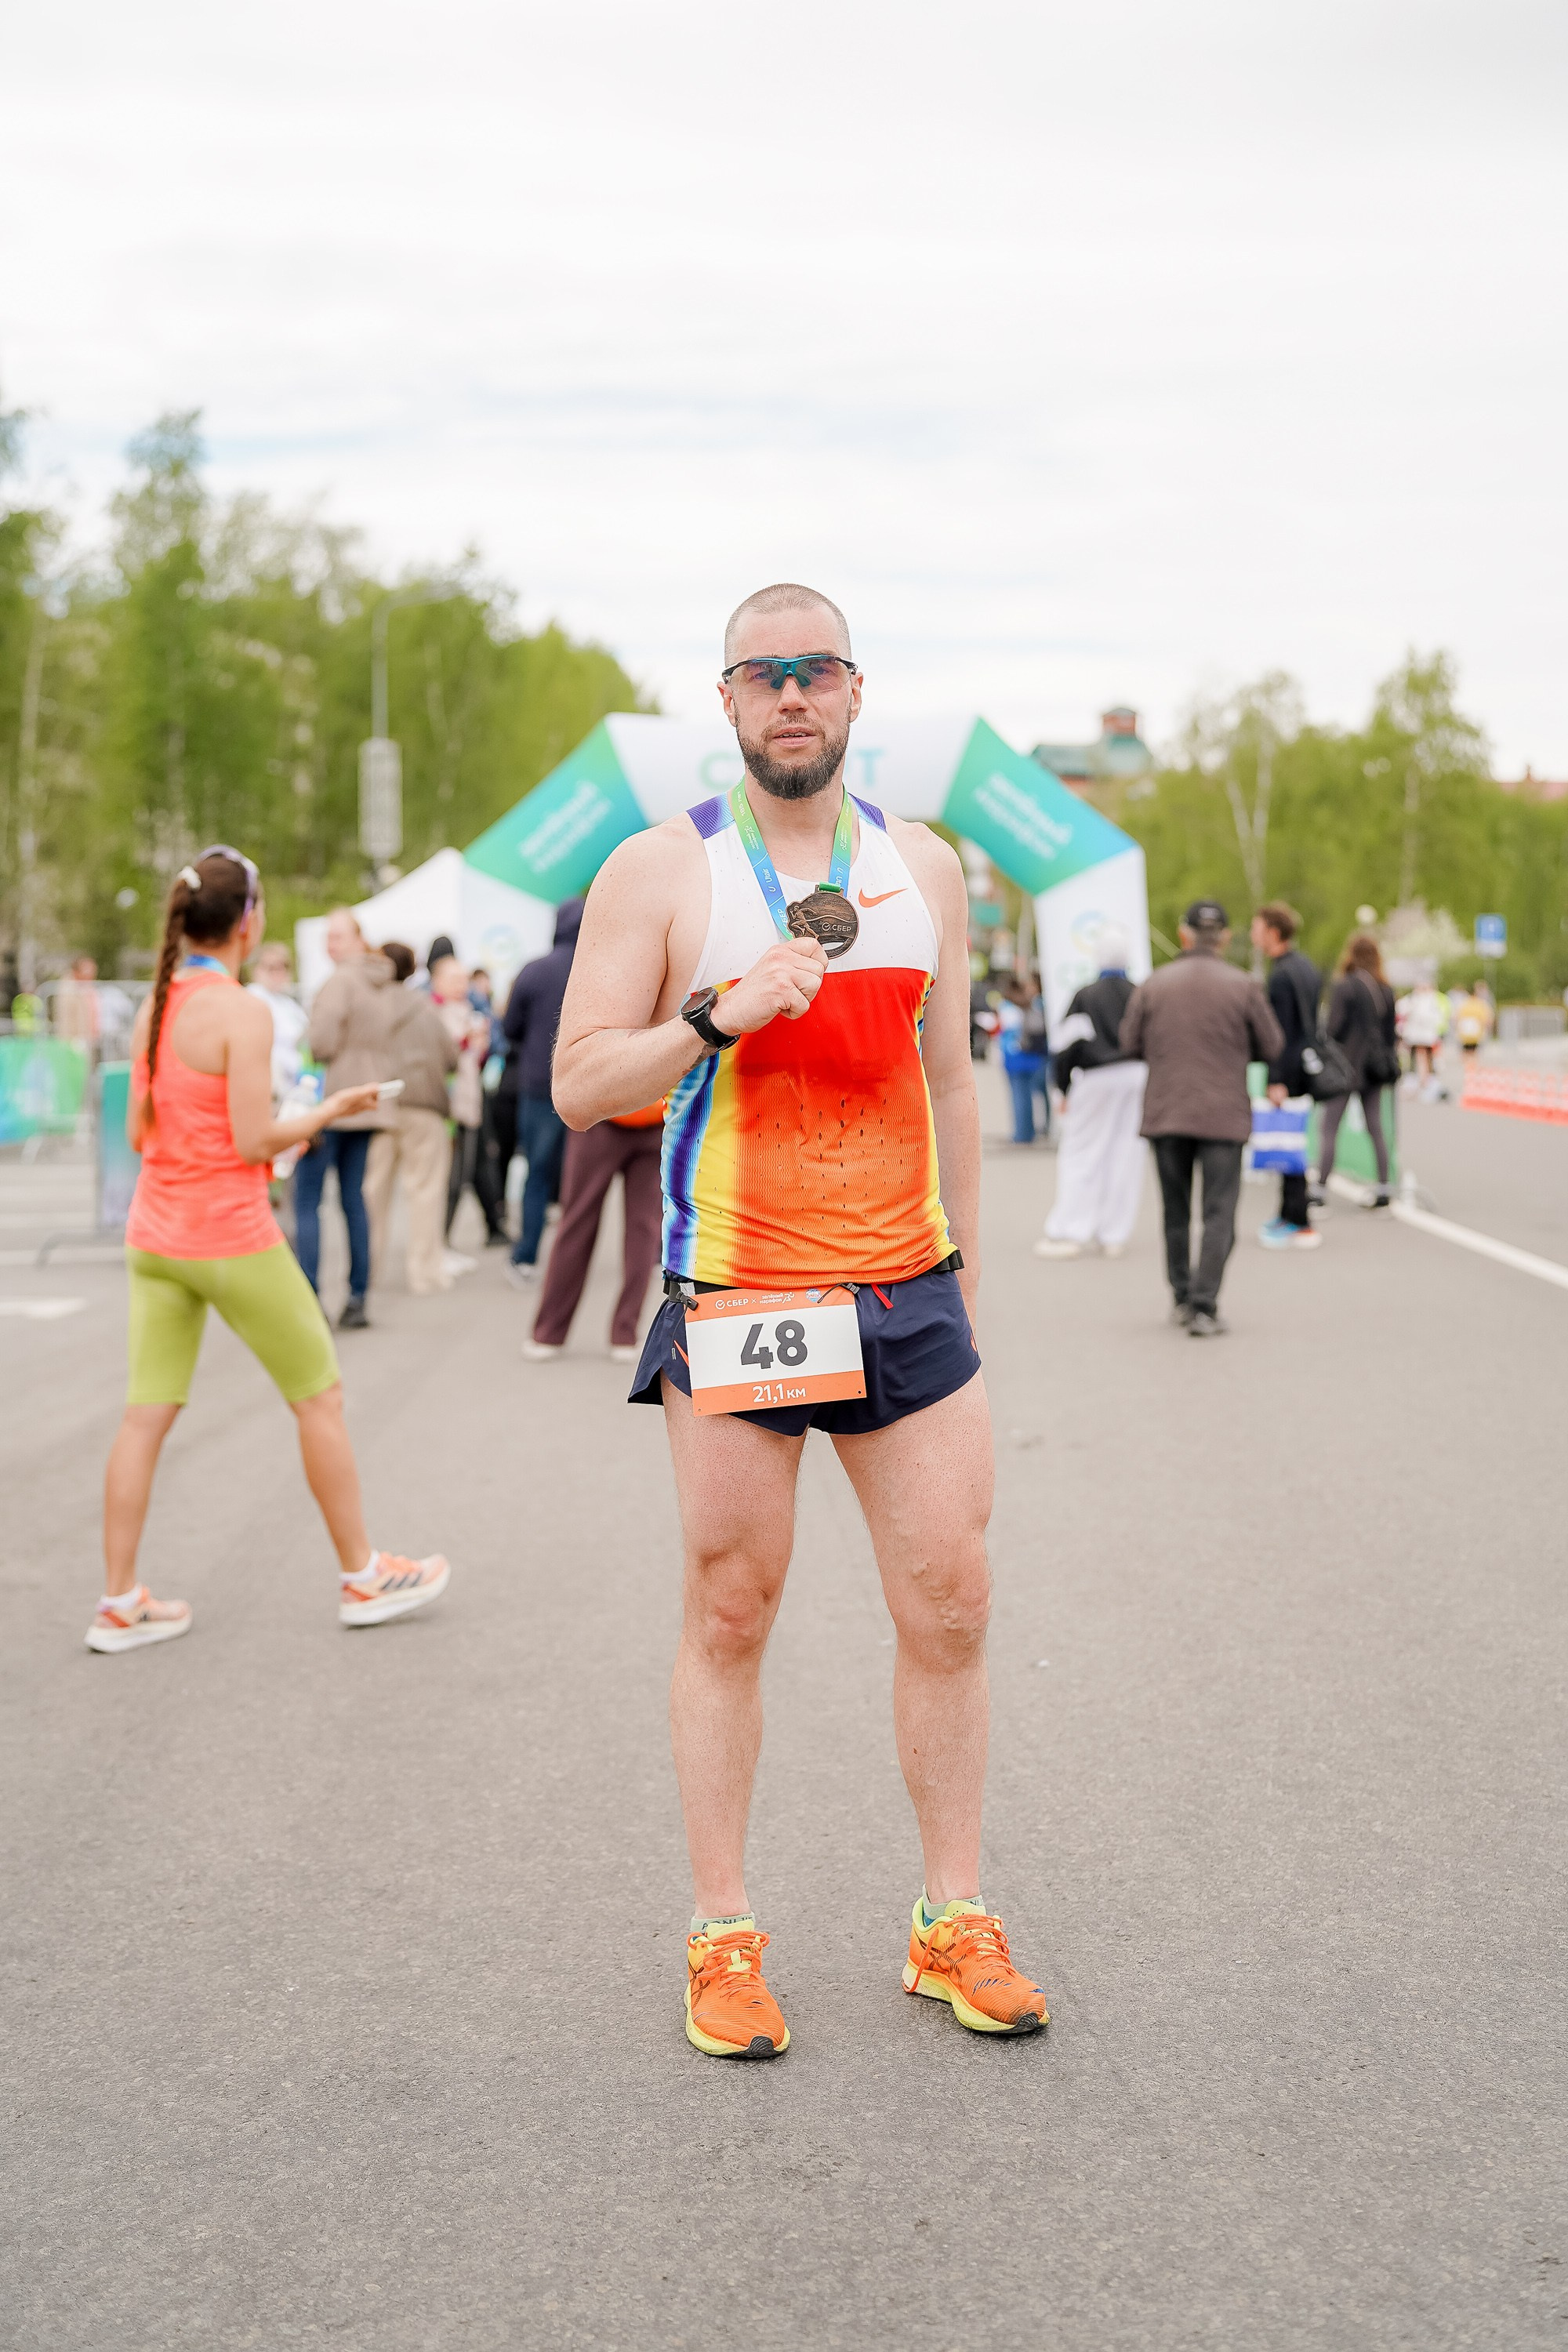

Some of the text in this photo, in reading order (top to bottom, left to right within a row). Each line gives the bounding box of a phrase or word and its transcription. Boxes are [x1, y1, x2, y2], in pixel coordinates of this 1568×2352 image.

[727, 1298, 748, 1307] СБЕР
[740, 1320, 808, 1369] 48
[753, 1383, 784, 1403] 21,1
